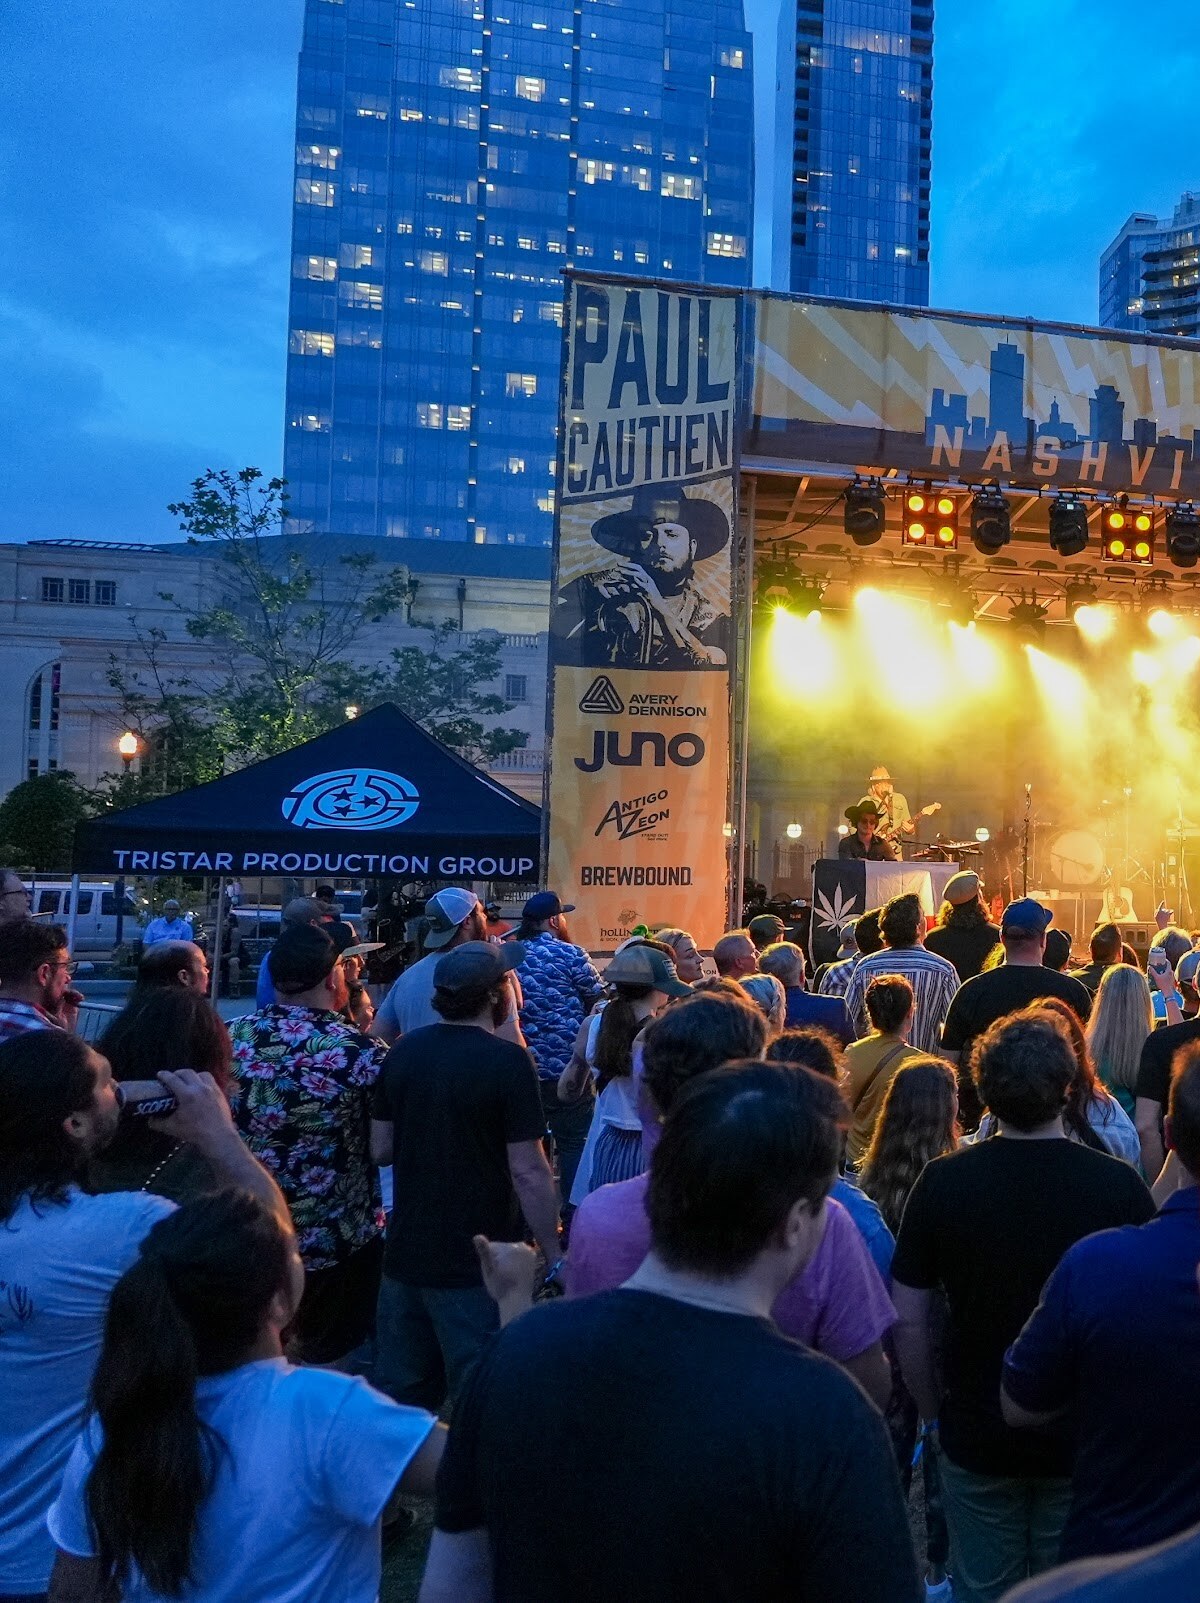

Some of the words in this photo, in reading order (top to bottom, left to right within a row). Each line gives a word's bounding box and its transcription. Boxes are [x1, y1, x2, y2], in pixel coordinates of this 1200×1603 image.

[571, 283, 730, 410] PAUL
[567, 409, 729, 494] CAUTHEN
[628, 706, 707, 717] DENNISON
[629, 694, 679, 705] AVERY
[113, 850, 233, 871] TRISTAR
[242, 852, 429, 875] PRODUCTION
[438, 857, 534, 877] GROUP
